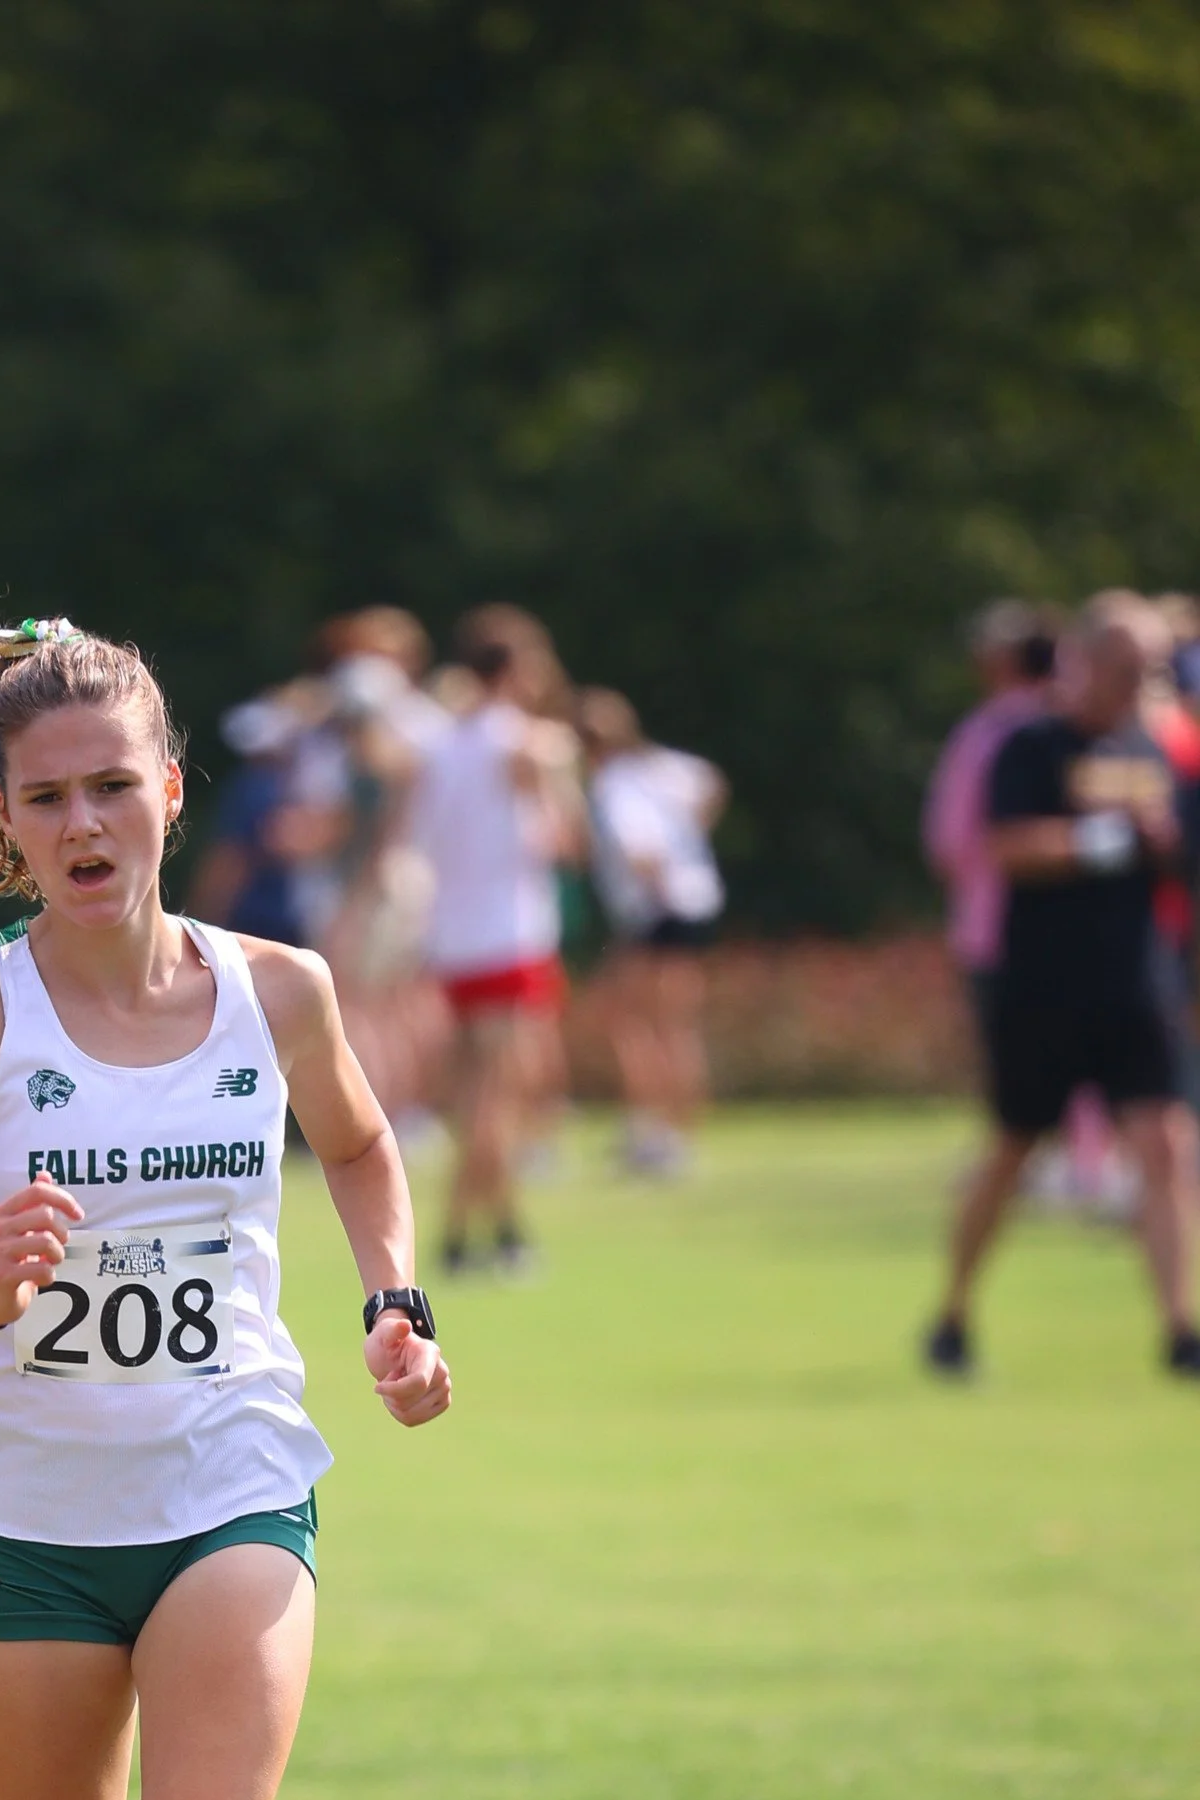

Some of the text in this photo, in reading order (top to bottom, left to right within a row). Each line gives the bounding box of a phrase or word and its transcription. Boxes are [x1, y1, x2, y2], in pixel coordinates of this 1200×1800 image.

[212, 1068, 258, 1098] NB
[28, 1141, 265, 1185] FALLS CHURCH
[106, 1258, 159, 1273] CLASSIC
[33, 1277, 218, 1368] 208
